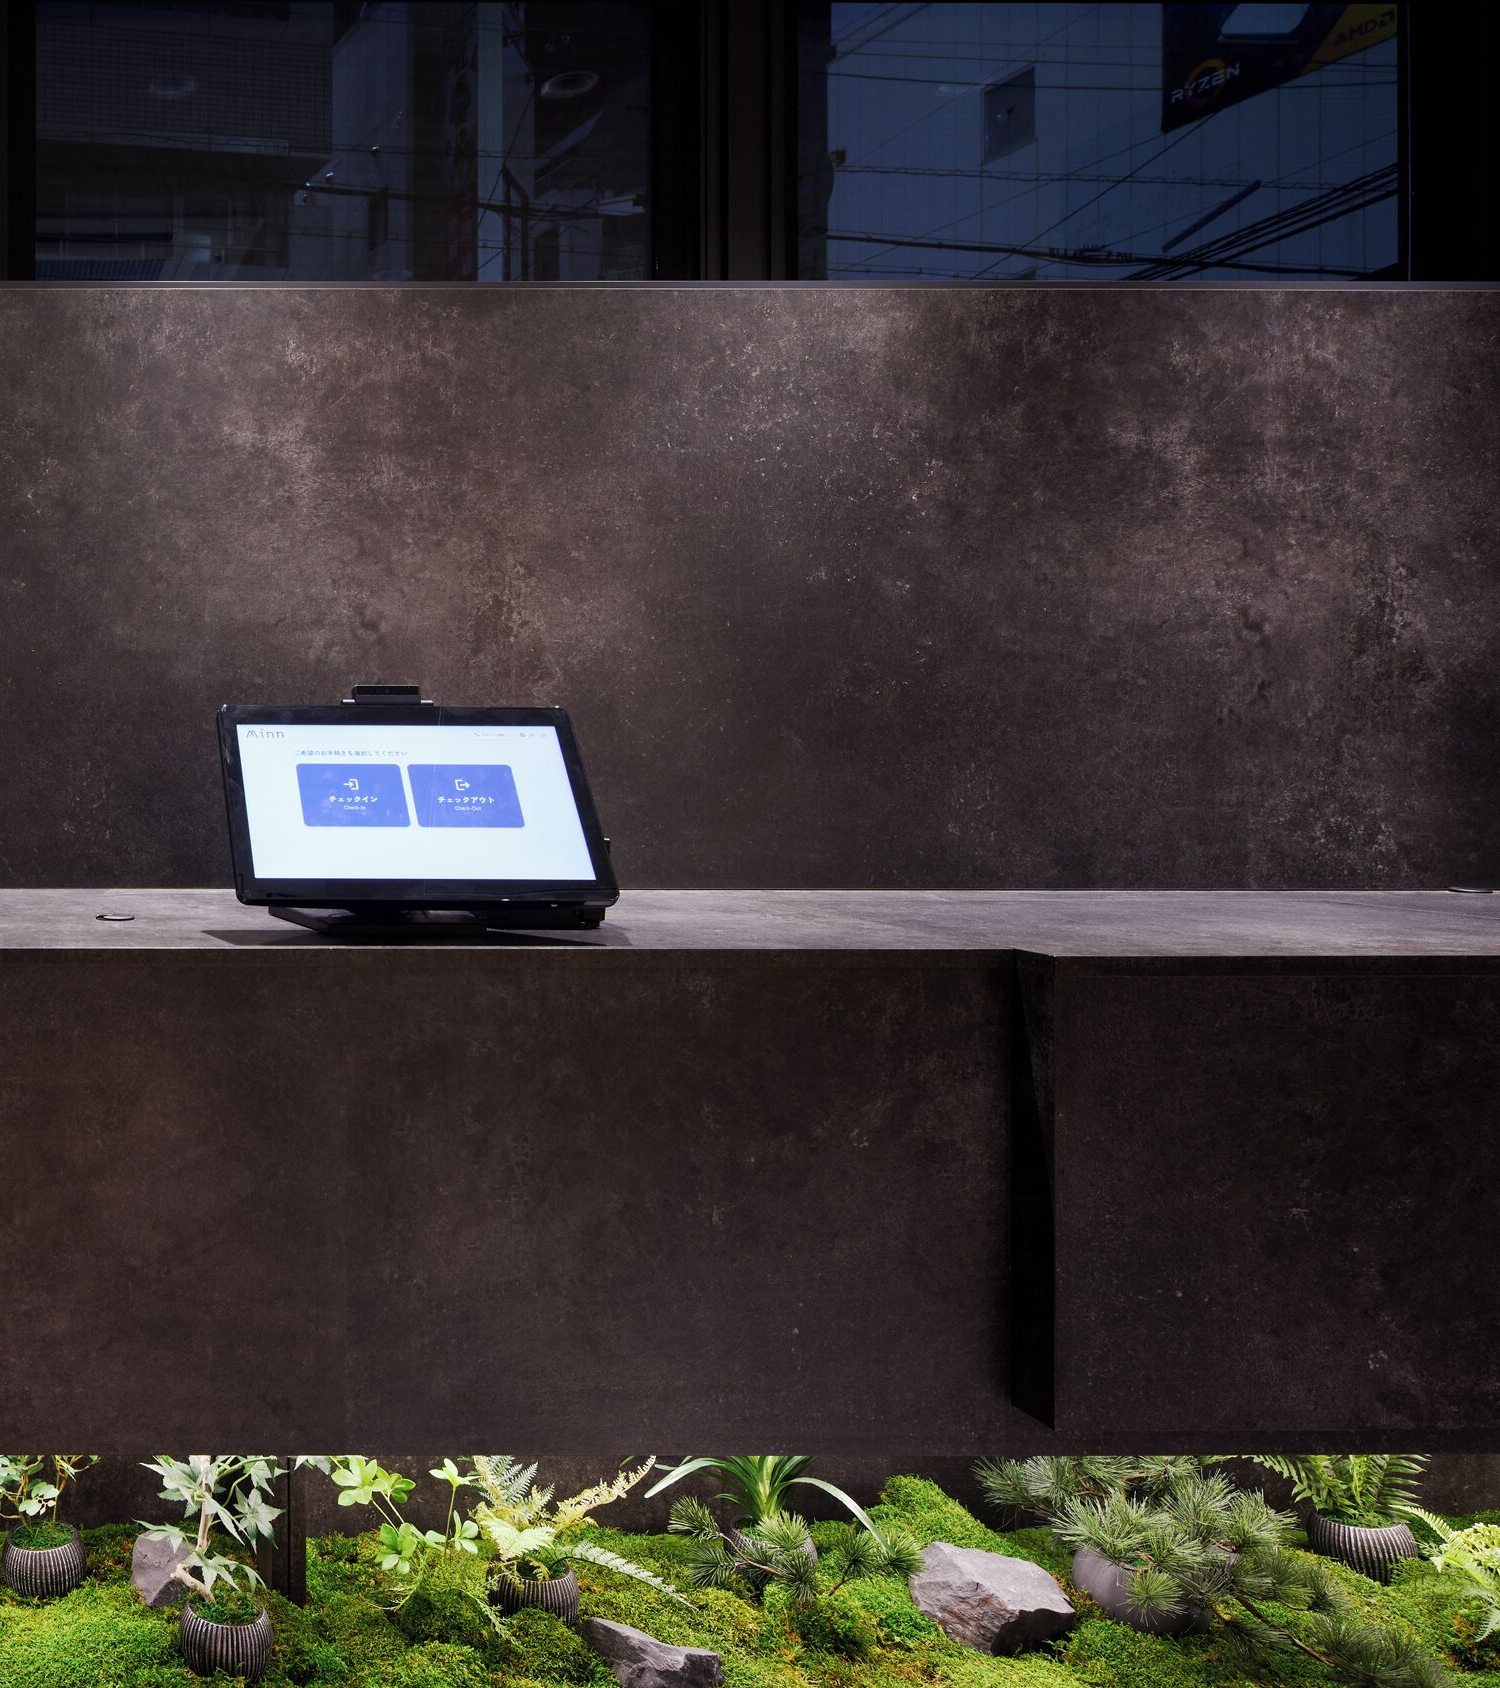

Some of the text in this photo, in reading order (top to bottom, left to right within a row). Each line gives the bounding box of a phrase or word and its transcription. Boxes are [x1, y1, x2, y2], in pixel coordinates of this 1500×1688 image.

[1335, 18, 1378, 48] AMD
[1171, 62, 1240, 104] RYZEN
[246, 729, 285, 739] Minn
[328, 795, 378, 804] チェックイン
[438, 795, 496, 804] チェックアウト
